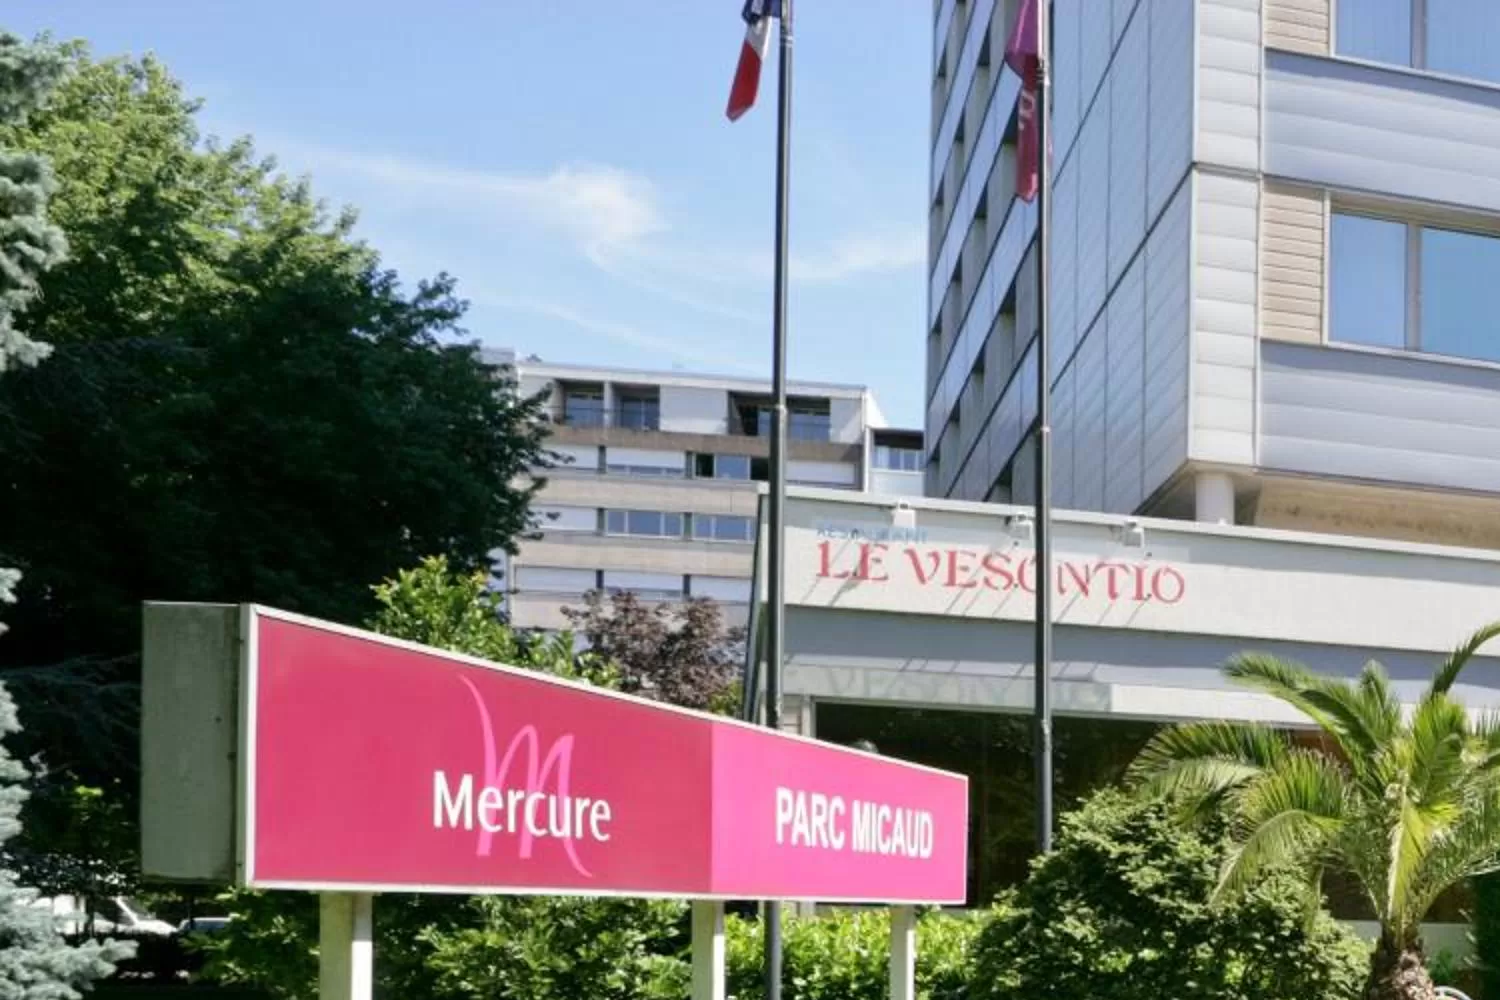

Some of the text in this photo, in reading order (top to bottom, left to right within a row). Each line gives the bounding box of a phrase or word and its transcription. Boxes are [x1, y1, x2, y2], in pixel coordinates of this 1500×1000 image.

[816, 541, 889, 582] LE
[433, 769, 612, 842] Mercure
[775, 786, 934, 859] PARC MICAUD
